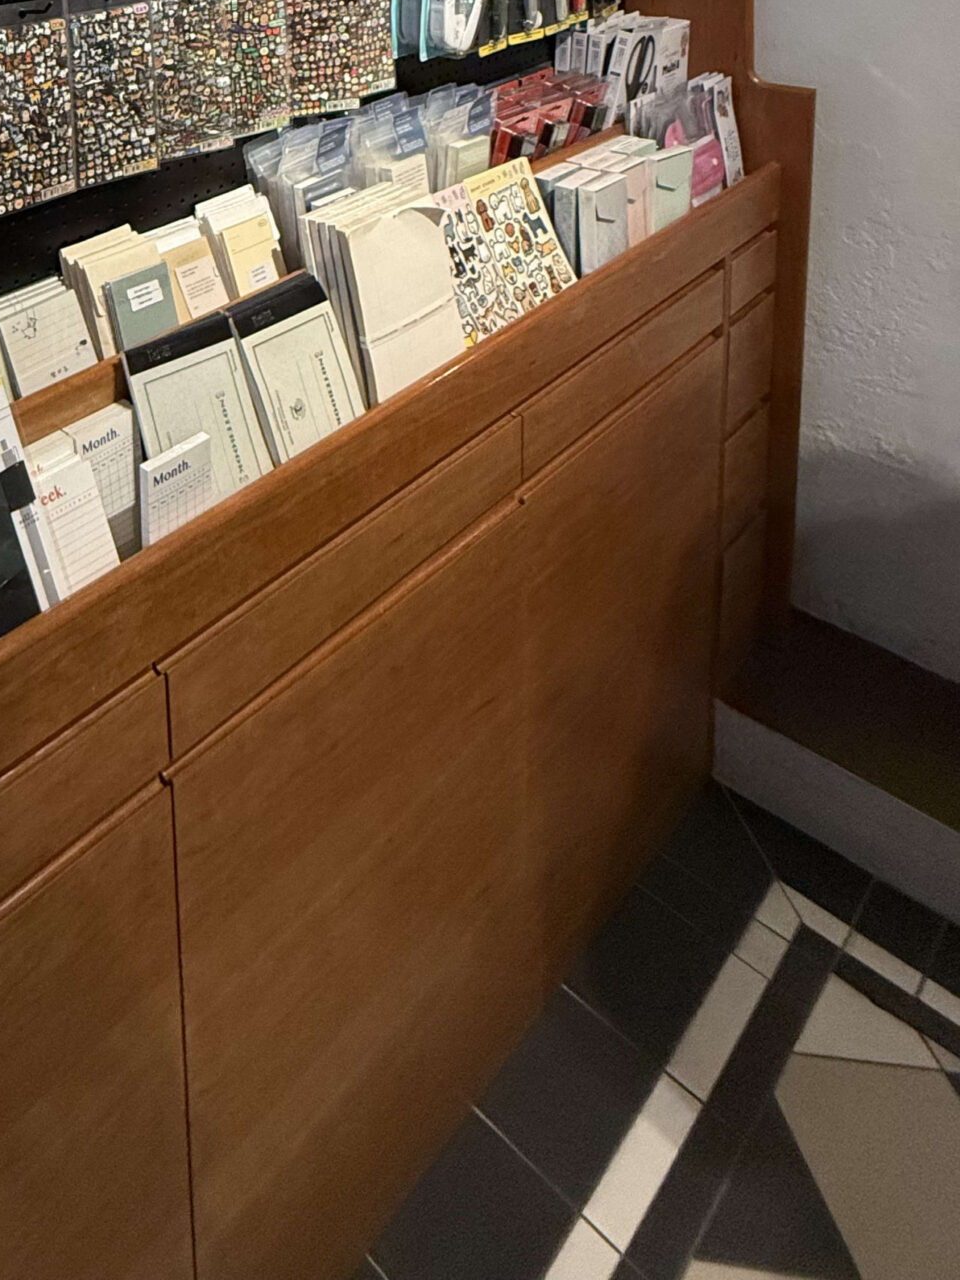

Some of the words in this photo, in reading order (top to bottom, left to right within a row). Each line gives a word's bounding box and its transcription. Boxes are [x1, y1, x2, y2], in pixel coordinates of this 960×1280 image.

[82, 427, 121, 456] Month.
[152, 459, 192, 488] Month.
[40, 485, 67, 506] eek.
